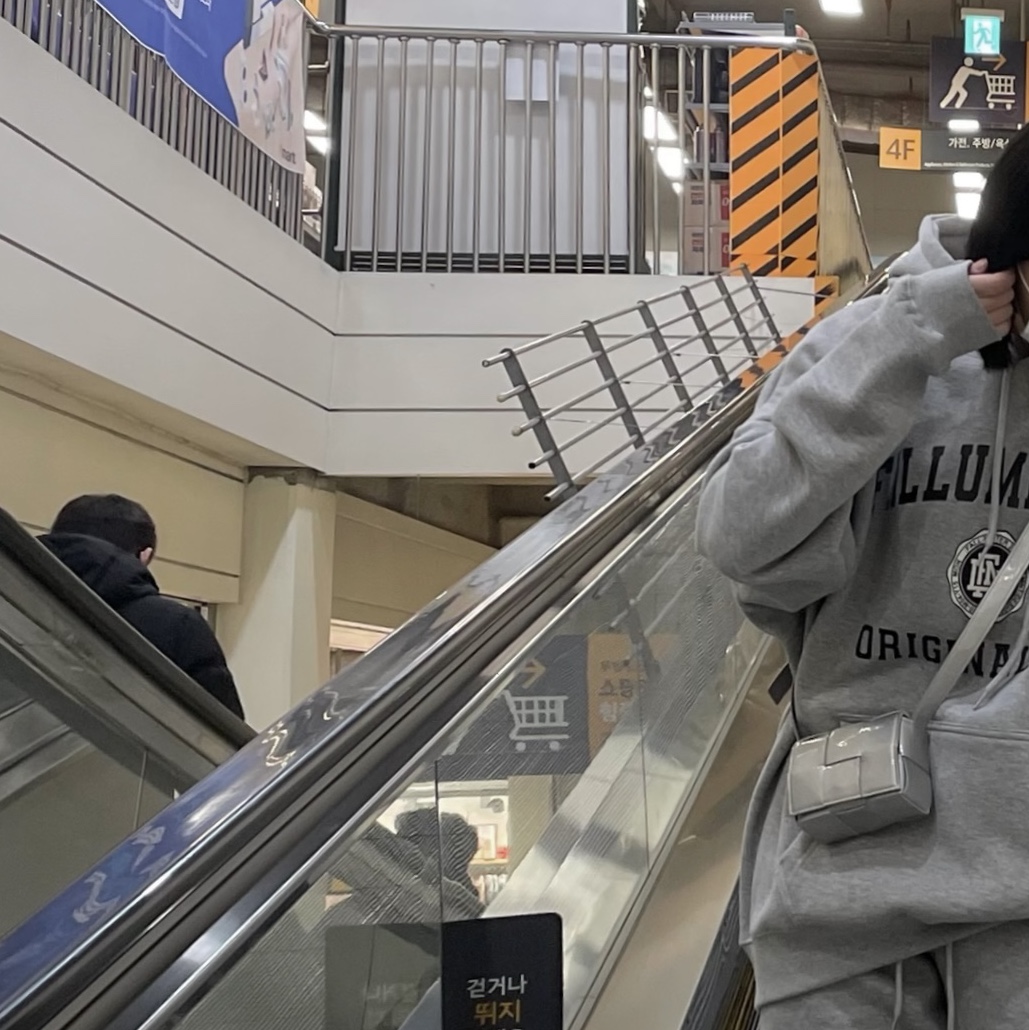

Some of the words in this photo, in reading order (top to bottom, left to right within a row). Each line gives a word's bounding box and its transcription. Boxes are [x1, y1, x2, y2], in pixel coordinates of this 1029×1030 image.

[886, 138, 916, 160] 4F
[467, 974, 528, 998] 걷거나
[474, 998, 521, 1025] 뛰지
